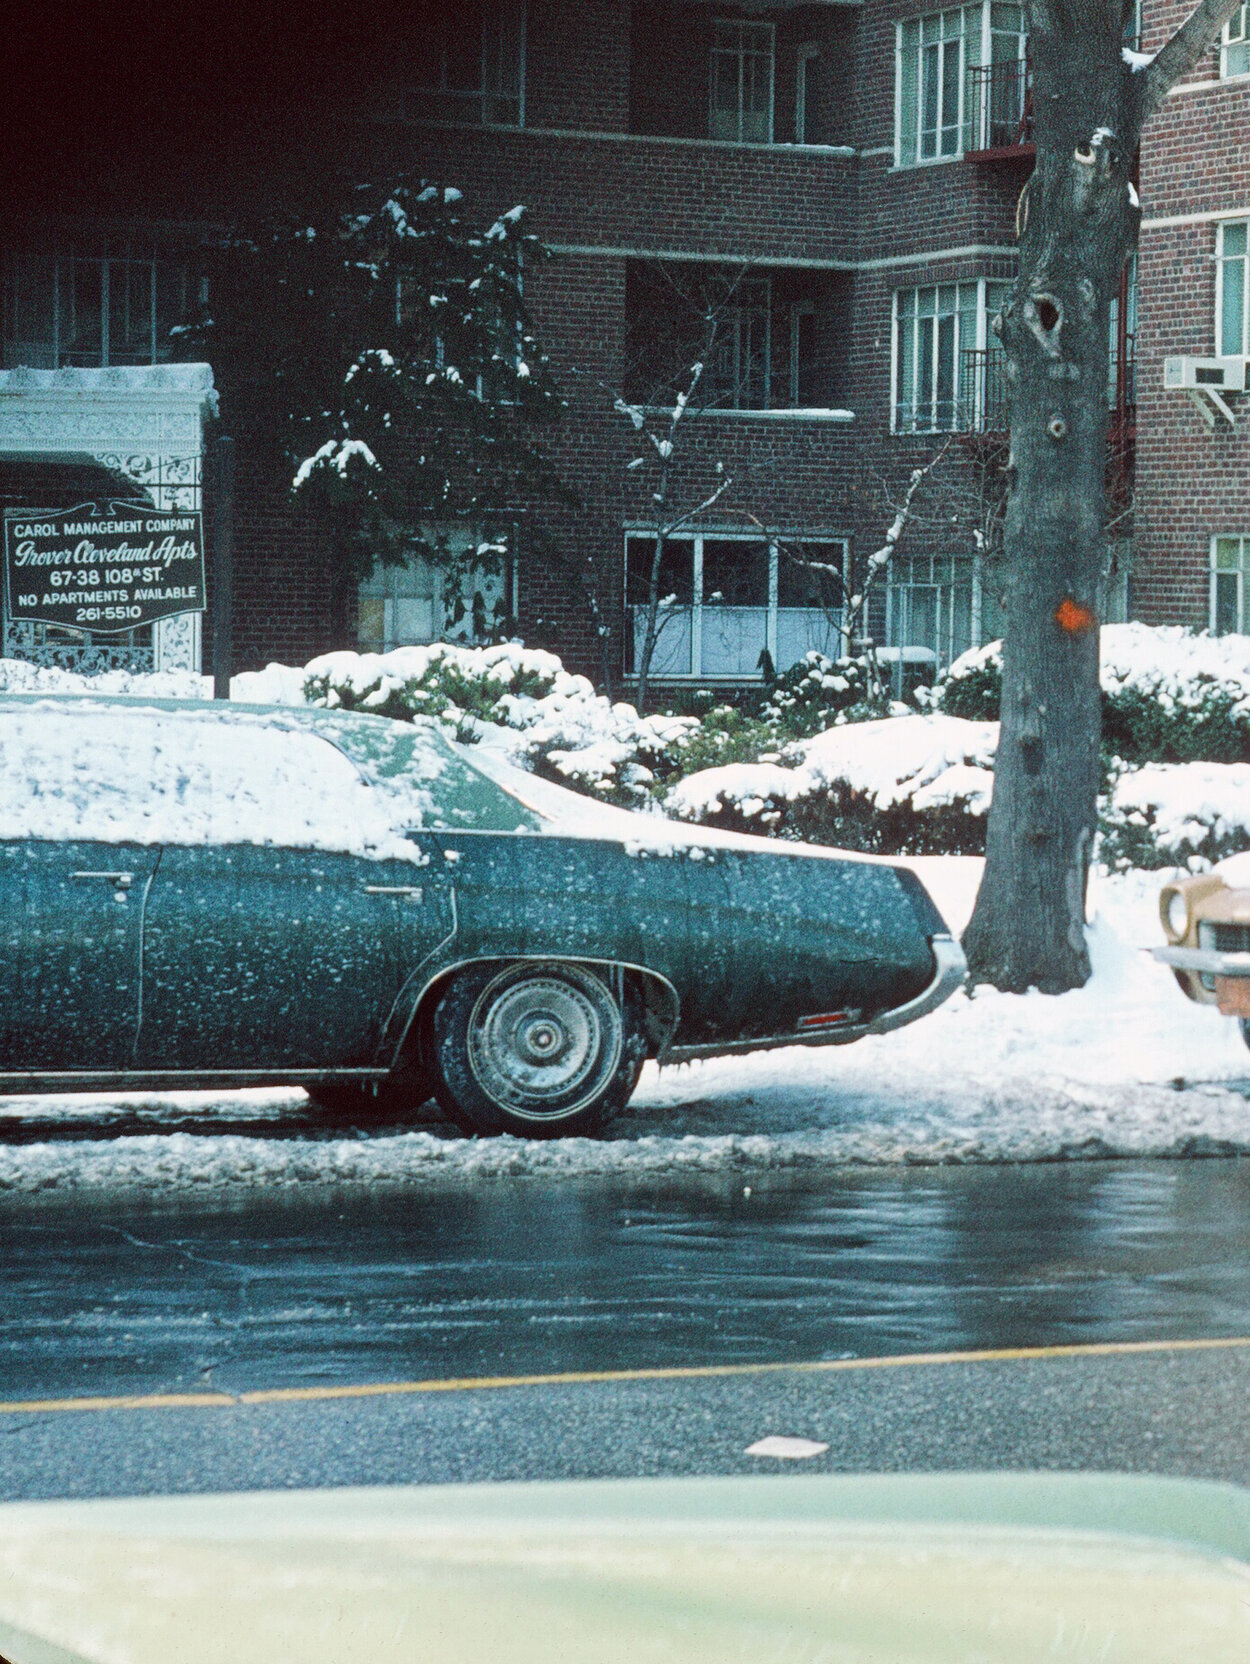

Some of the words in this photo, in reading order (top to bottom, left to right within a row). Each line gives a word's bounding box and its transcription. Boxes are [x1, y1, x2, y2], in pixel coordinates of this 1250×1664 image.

[14, 524, 60, 538] CAROL
[63, 520, 143, 535] MANAGEMENT
[145, 518, 195, 532] COMPANY
[14, 540, 72, 567] Grover
[73, 539, 154, 564] Cleveland
[152, 536, 198, 567] Apts
[142, 566, 164, 582] ST.
[18, 594, 38, 606] NO
[42, 590, 129, 605] APARTMENTS
[133, 586, 197, 601] AVAILABLE
